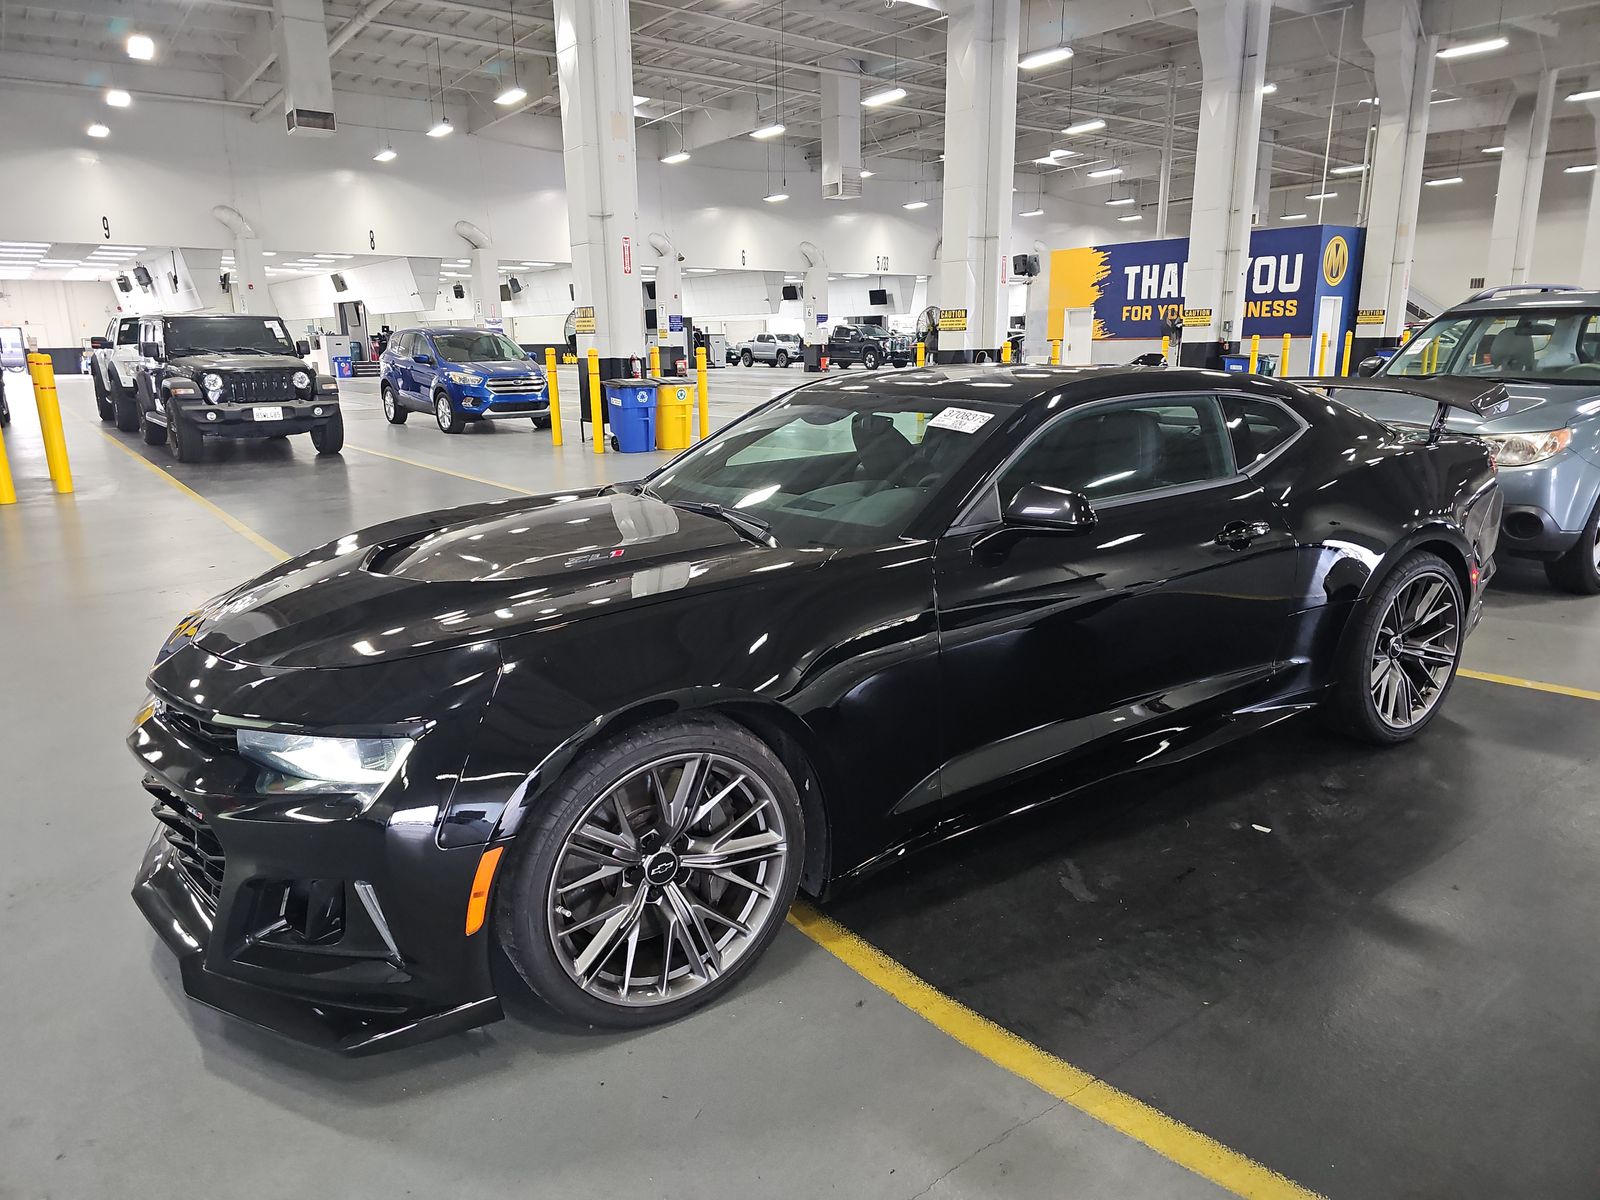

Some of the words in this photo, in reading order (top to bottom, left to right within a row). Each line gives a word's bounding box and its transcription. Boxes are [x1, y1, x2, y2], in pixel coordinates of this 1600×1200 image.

[102, 216, 111, 240] 9
[369, 229, 376, 250] 8
[741, 249, 746, 266] 6
[1124, 262, 1188, 301] THA
[941, 309, 966, 319] CAUTION
[1122, 305, 1152, 321] FOR
[1243, 299, 1298, 318] INESS
[1184, 309, 1210, 317] CAUTION
